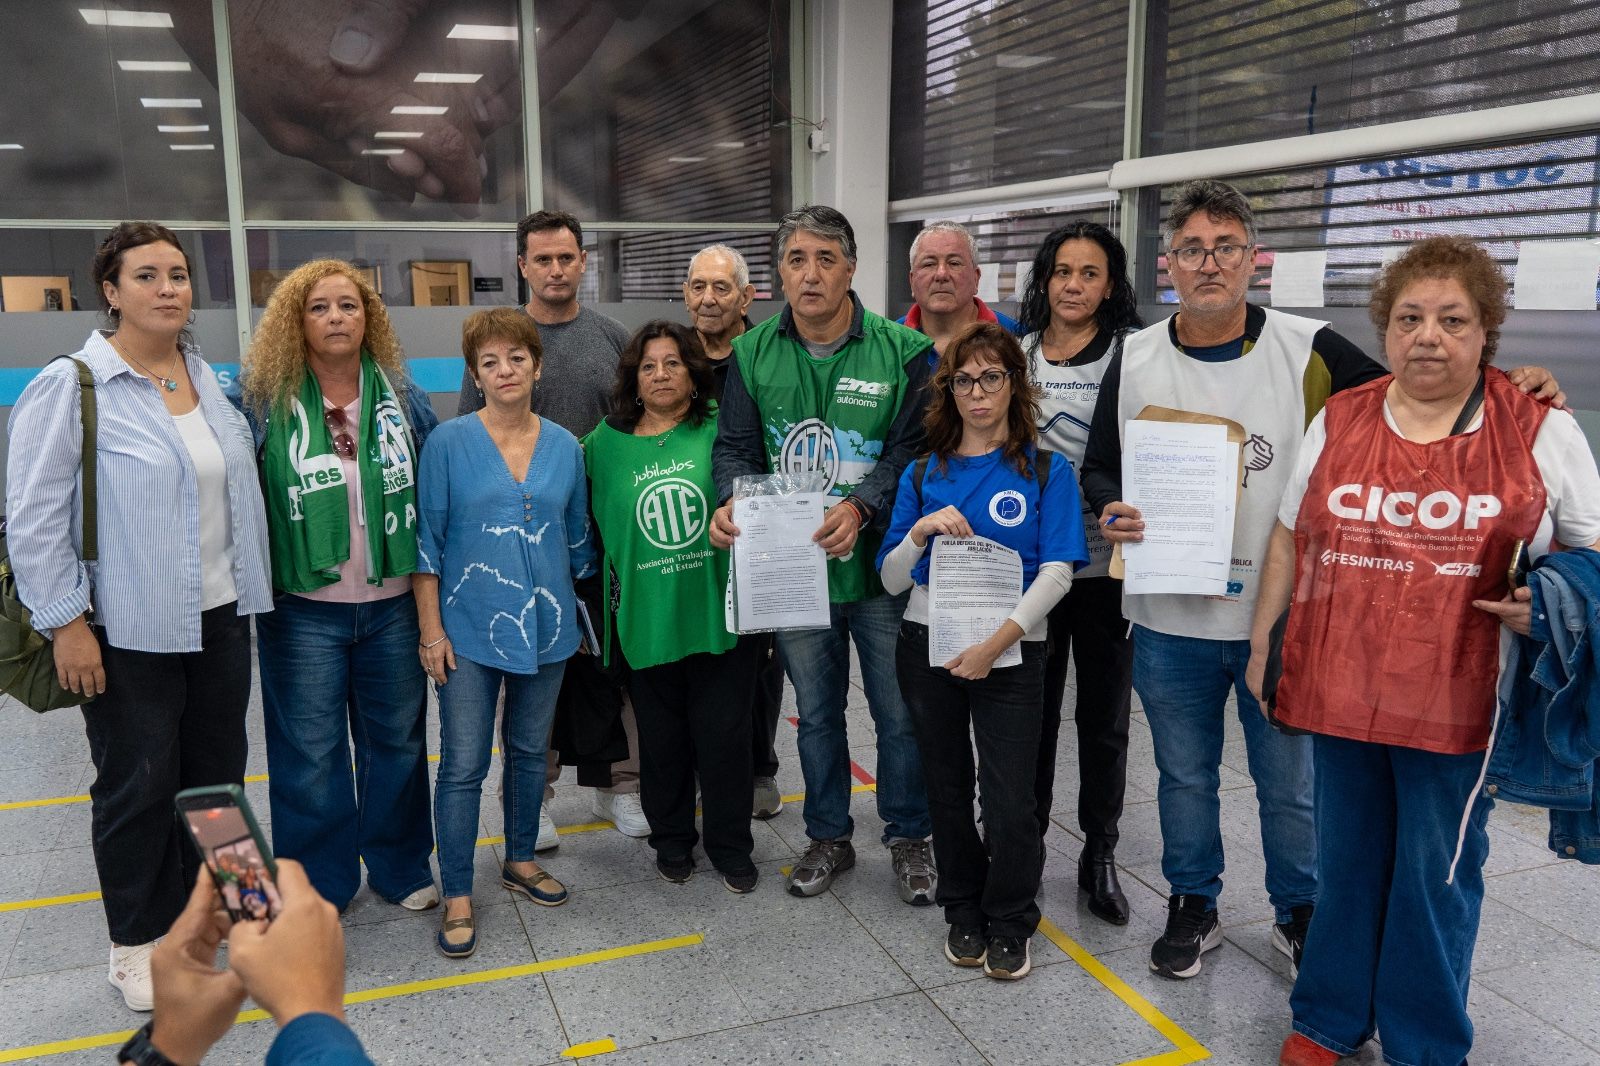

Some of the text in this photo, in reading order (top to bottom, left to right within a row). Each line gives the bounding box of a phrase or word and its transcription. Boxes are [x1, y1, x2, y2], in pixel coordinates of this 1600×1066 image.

[836, 396, 878, 408] autónoma
[632, 458, 696, 487] jubilados
[642, 484, 701, 543] ATE
[1326, 483, 1502, 530] CICOP
[1335, 523, 1484, 543] Asociación Sindical de Profesionales de la
[1342, 533, 1475, 552] Salud de la Provincia de Buenos Aires
[636, 554, 675, 571] Asociación
[661, 561, 703, 575] del Estado
[1230, 557, 1253, 567] ÚBLICA
[1331, 551, 1415, 573] FESINTRAS
